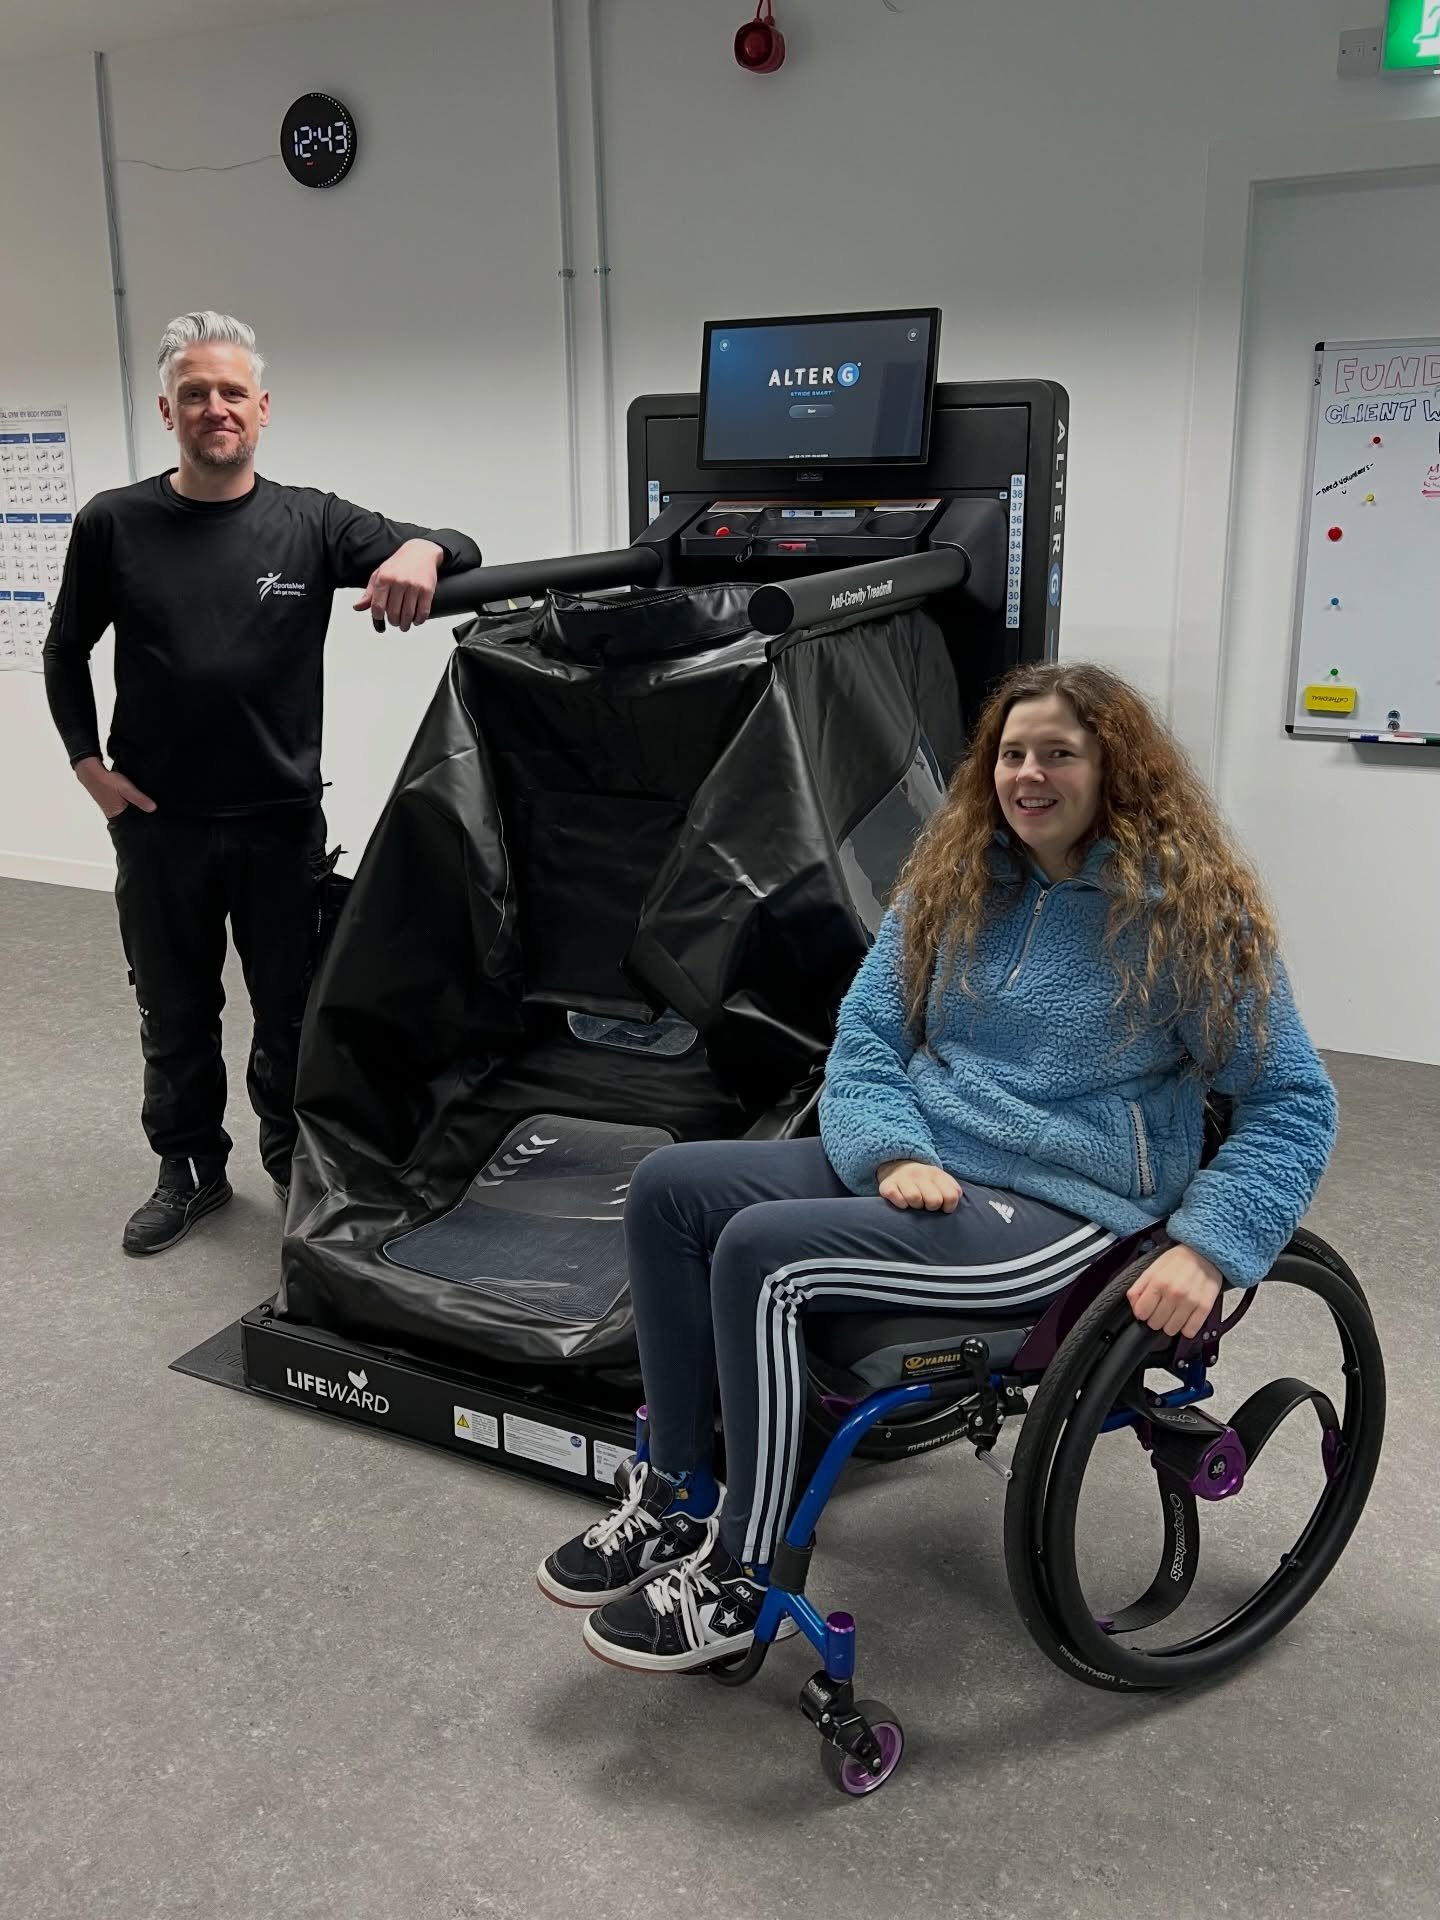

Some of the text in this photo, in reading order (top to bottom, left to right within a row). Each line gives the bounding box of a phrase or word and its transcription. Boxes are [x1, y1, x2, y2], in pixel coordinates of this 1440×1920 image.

[293, 121, 348, 159] 12:43
[1325, 399, 1417, 425] CLIENT
[1013, 476, 1024, 487] IN
[1012, 490, 1024, 499] 38
[1011, 502, 1023, 511] 37
[1011, 515, 1023, 524] 36
[1010, 528, 1022, 537] 35
[1009, 541, 1021, 550] 34
[1009, 553, 1021, 563] 33
[1009, 566, 1020, 575] 32
[1008, 579, 1019, 588] 31
[829, 579, 893, 611] Anti-Gravity Treadmill
[1008, 591, 1019, 600] 30
[1007, 604, 1018, 613] 29
[1007, 616, 1018, 625] 28
[286, 1367, 390, 1414] LIFEWARD
[1059, 1644, 1116, 1683] MARATHON
